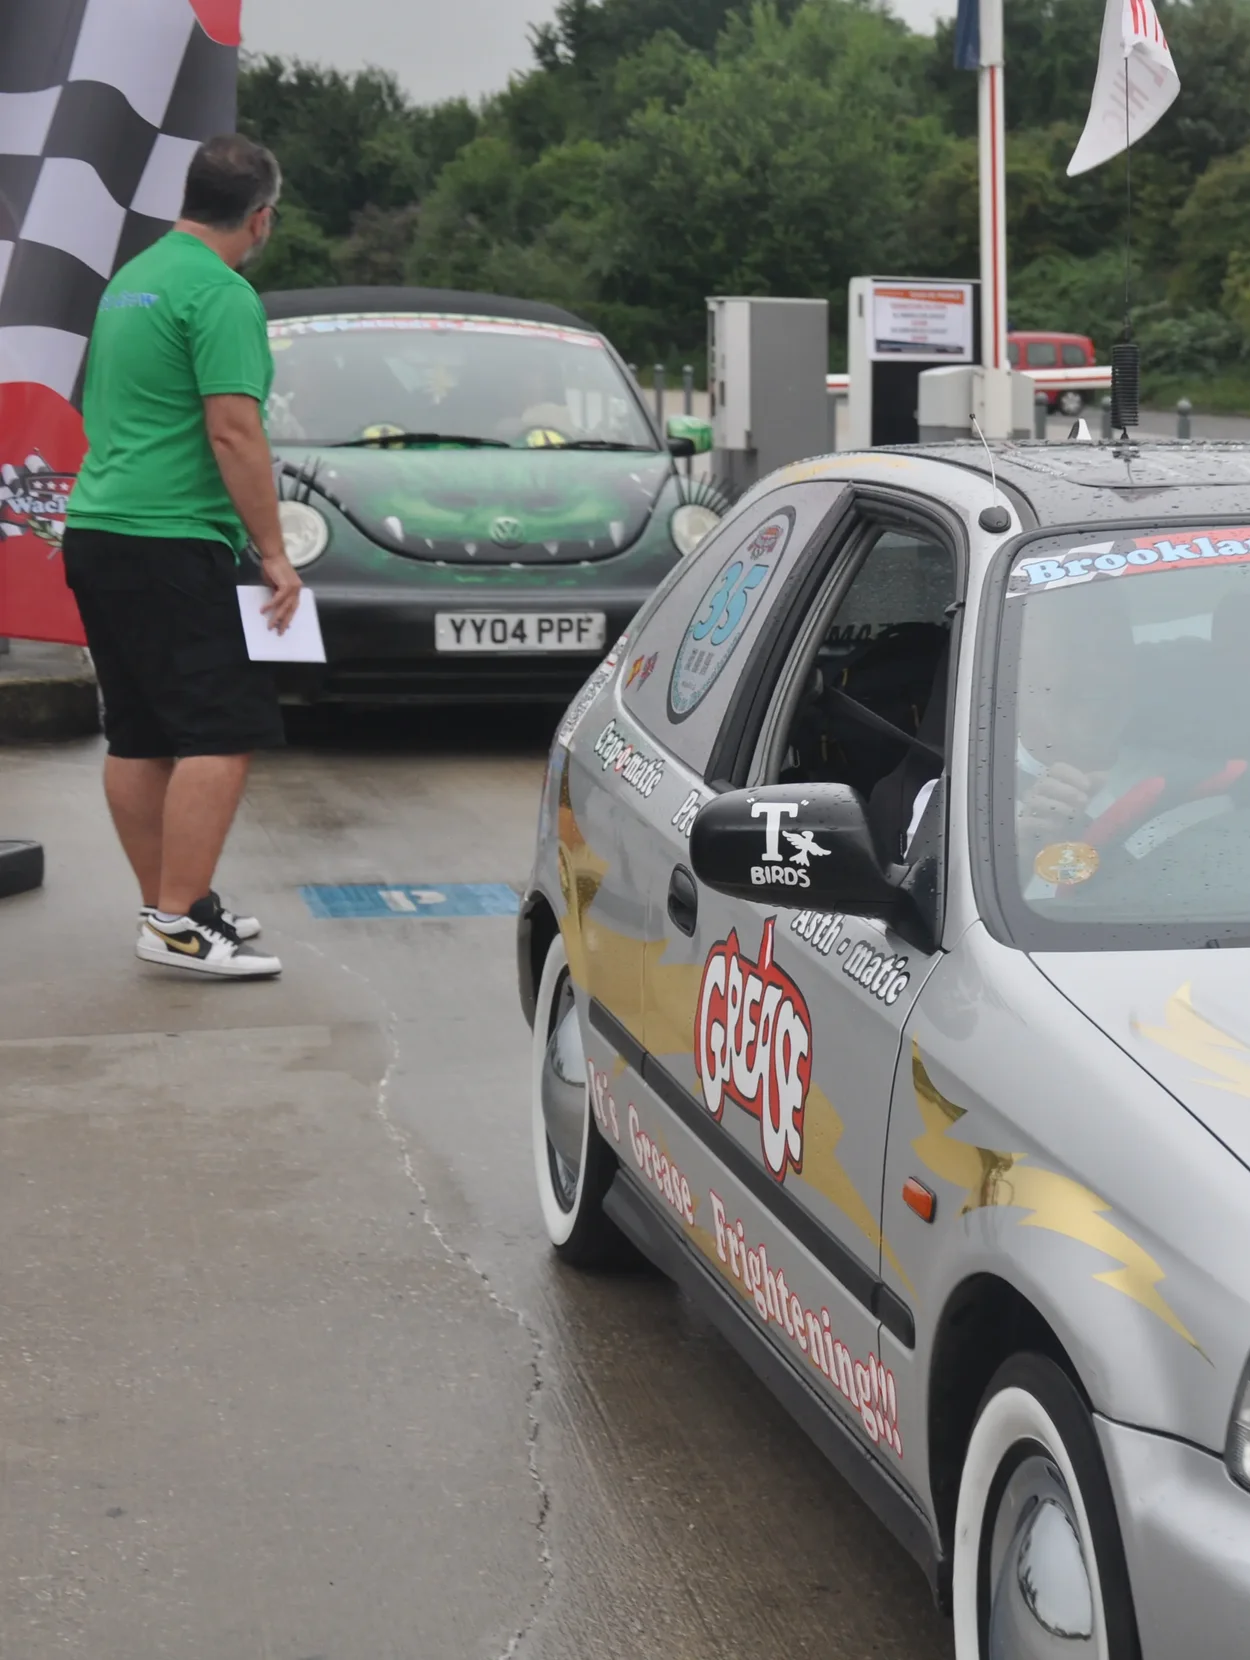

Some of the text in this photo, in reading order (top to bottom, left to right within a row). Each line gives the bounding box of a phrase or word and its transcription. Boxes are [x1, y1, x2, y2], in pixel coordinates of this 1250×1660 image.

[449, 618, 593, 644] YY04 PPF
[692, 560, 770, 647] 35
[751, 865, 811, 888] BIRDS
[587, 1058, 904, 1459] It's Grease Frightening!!!
